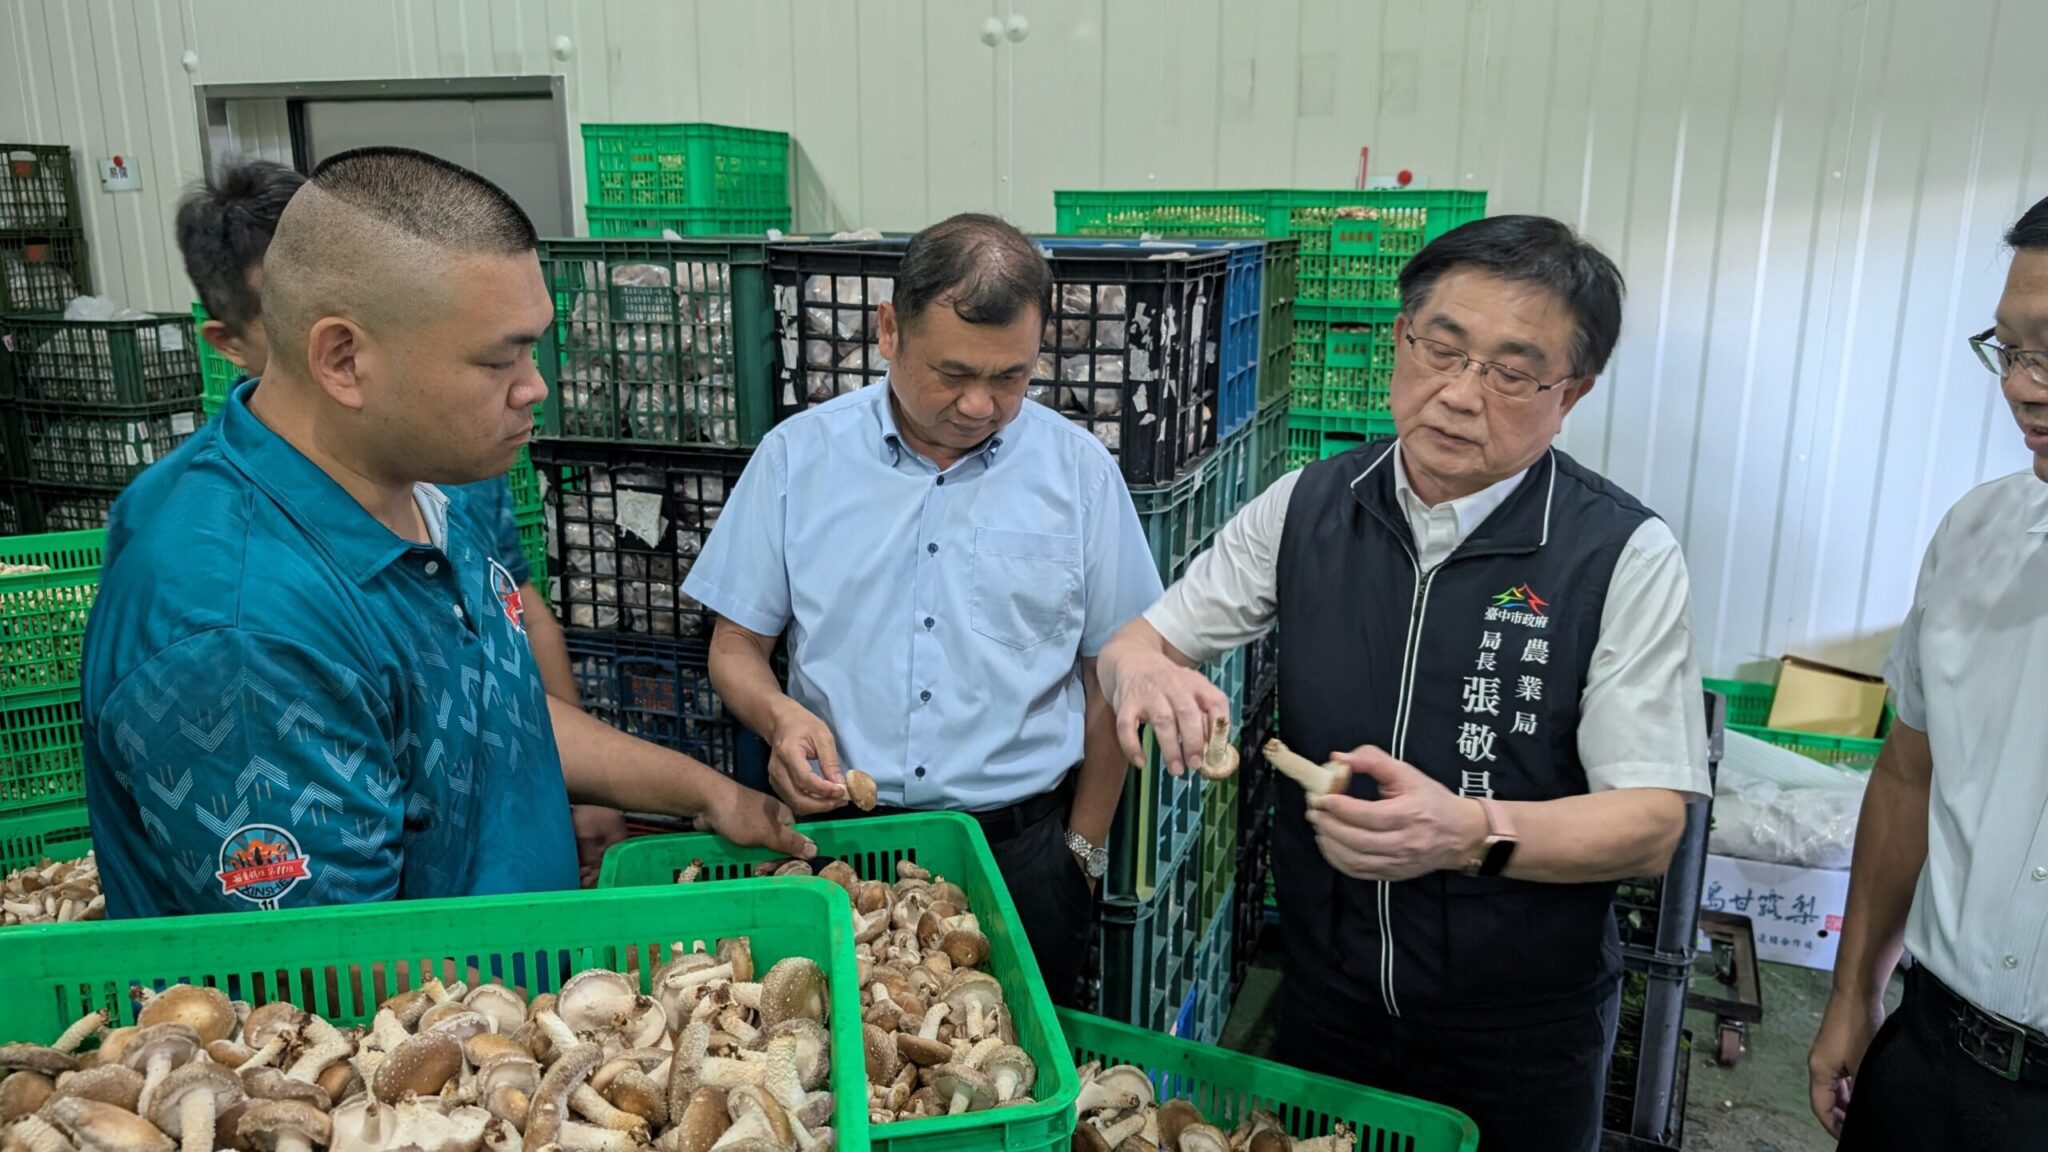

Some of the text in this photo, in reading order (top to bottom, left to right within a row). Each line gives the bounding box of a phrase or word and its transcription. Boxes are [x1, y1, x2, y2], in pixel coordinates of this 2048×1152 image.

[1484, 606, 1549, 629] 臺中市政府
[1509, 638, 1549, 736] 農業局
